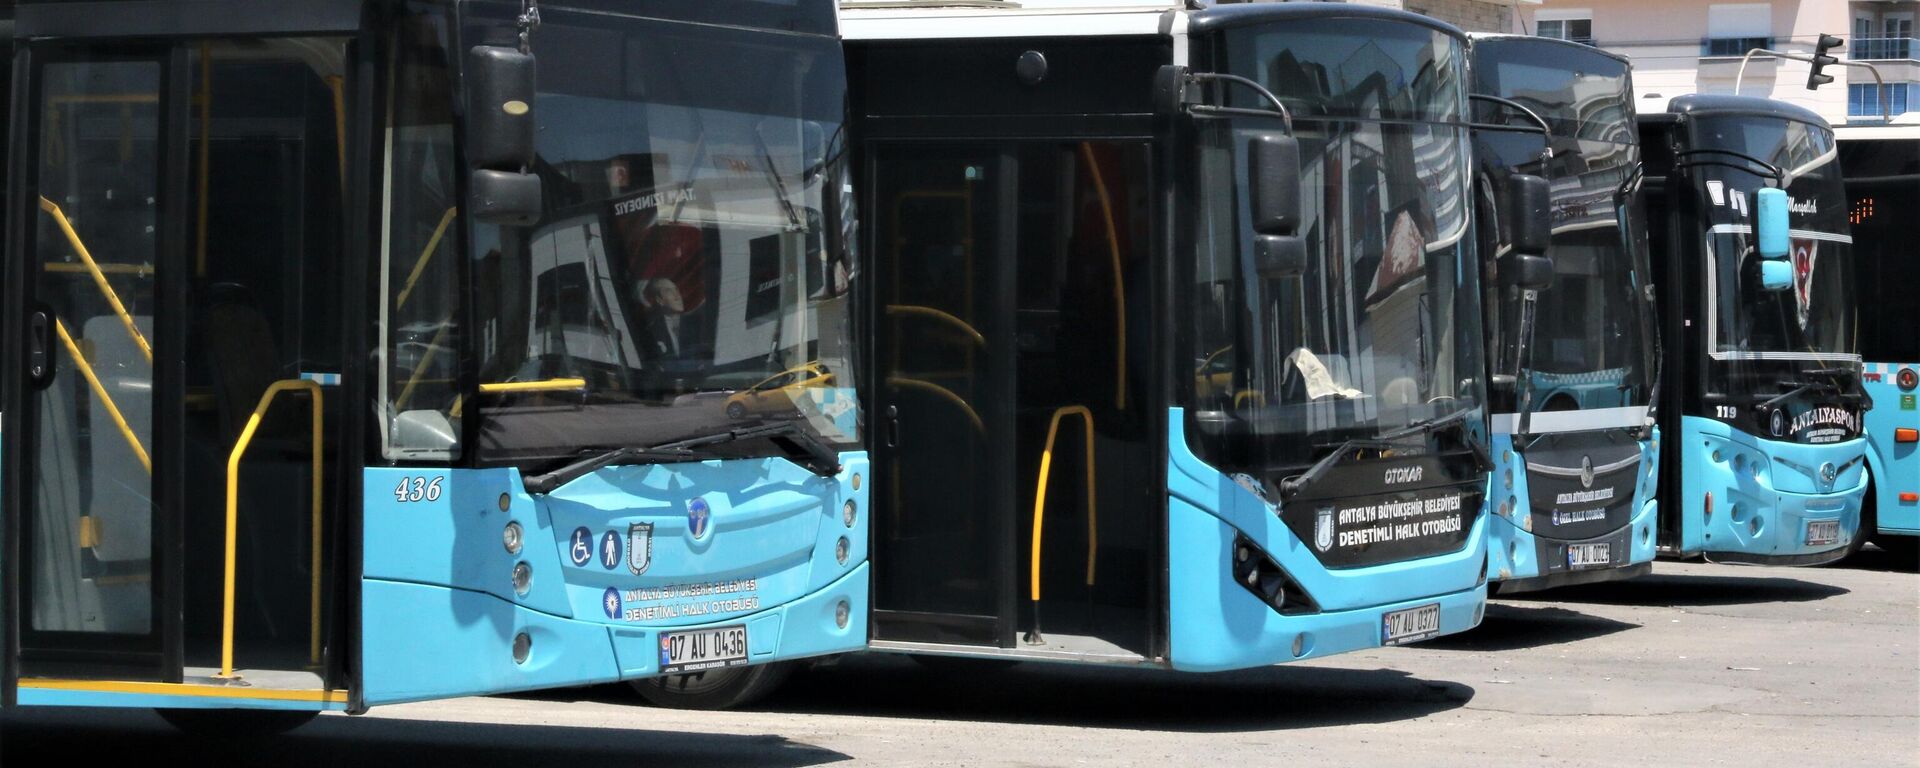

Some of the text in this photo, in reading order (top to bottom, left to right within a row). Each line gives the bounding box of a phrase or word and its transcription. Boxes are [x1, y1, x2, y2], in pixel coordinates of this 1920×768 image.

[1716, 405, 1737, 418] 119
[1789, 407, 1855, 435] ANTALYASPOR
[1384, 465, 1423, 484] OTOKAR
[394, 476, 444, 502] 436
[1339, 492, 1461, 525] ANTALYA BÜYÜKŞEHİR BELEDİYESİ
[1339, 527, 1393, 547] DENETİMLİ
[1395, 524, 1420, 541] HALK
[1422, 514, 1461, 536] OTOBÜSÜ
[1572, 546, 1579, 562] 07
[1582, 545, 1589, 562] AU
[625, 577, 758, 602] ANTALYA BÜYÜKŞEHİR BELEDİYESİ
[625, 598, 759, 622] DENETİMLİ HALK OTOBÜSÜ
[1390, 608, 1437, 635] 07 AU 0377
[669, 629, 744, 661] 07 AU 0436
